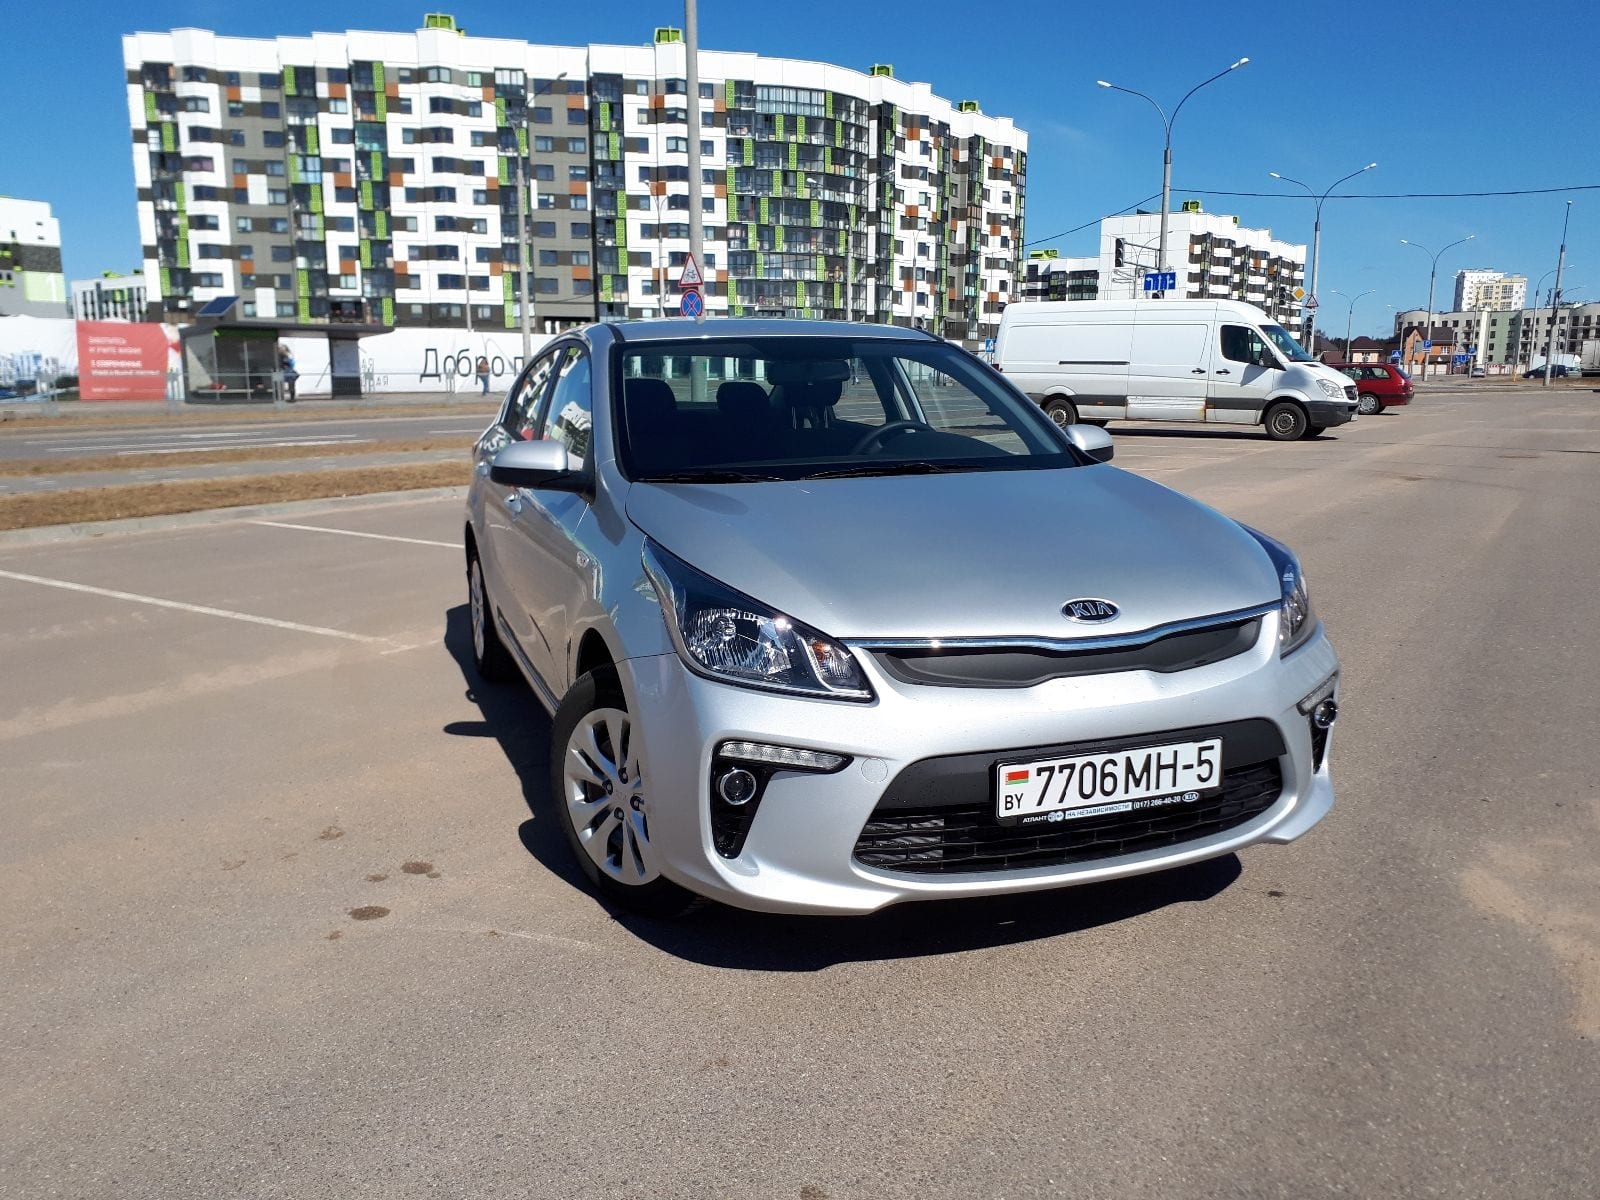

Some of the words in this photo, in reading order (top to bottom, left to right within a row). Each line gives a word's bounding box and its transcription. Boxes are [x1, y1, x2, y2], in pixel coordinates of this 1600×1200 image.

[1067, 601, 1114, 619] KIA
[1004, 793, 1024, 811] BY
[1022, 815, 1048, 824] АТЛАНТ
[1133, 800, 1150, 810] (017)
